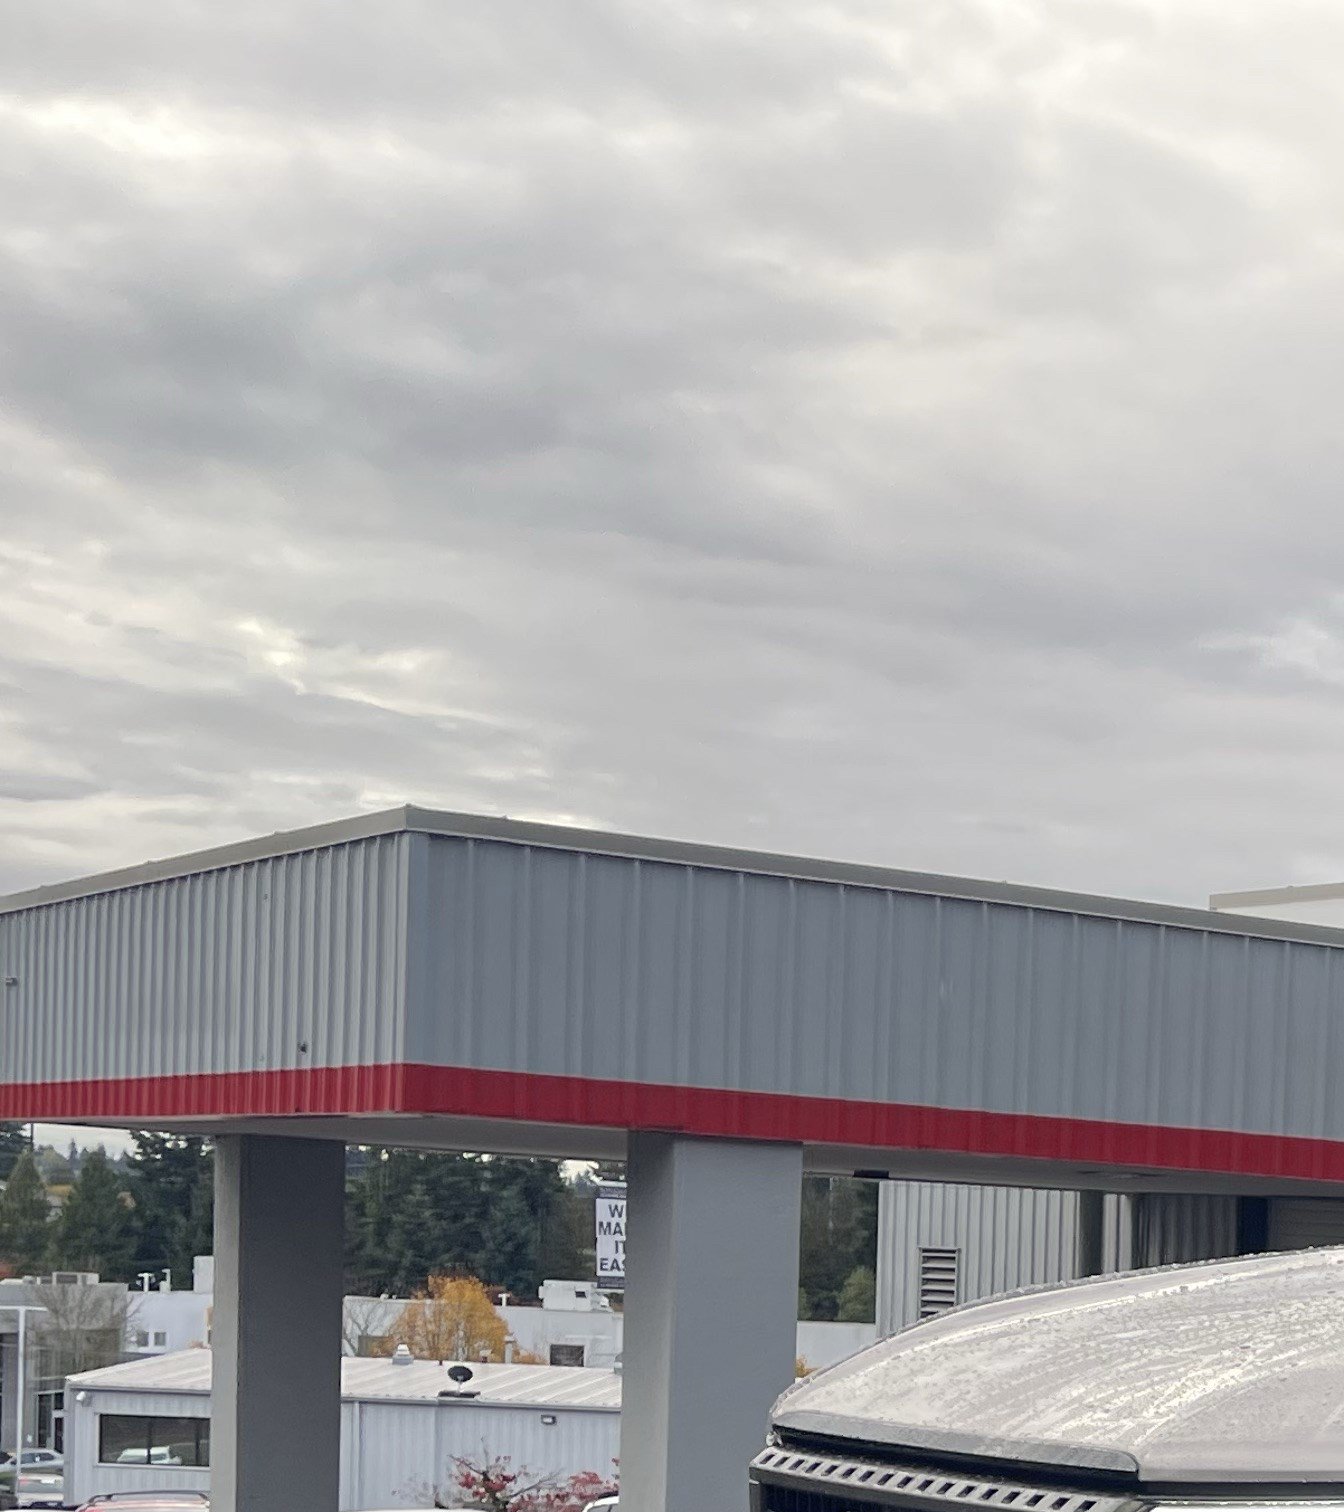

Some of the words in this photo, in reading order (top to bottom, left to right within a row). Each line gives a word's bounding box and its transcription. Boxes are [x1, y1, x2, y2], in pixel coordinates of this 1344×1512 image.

[608, 1204, 624, 1218] W
[599, 1221, 623, 1236] MA
[600, 1258, 625, 1271] EA
